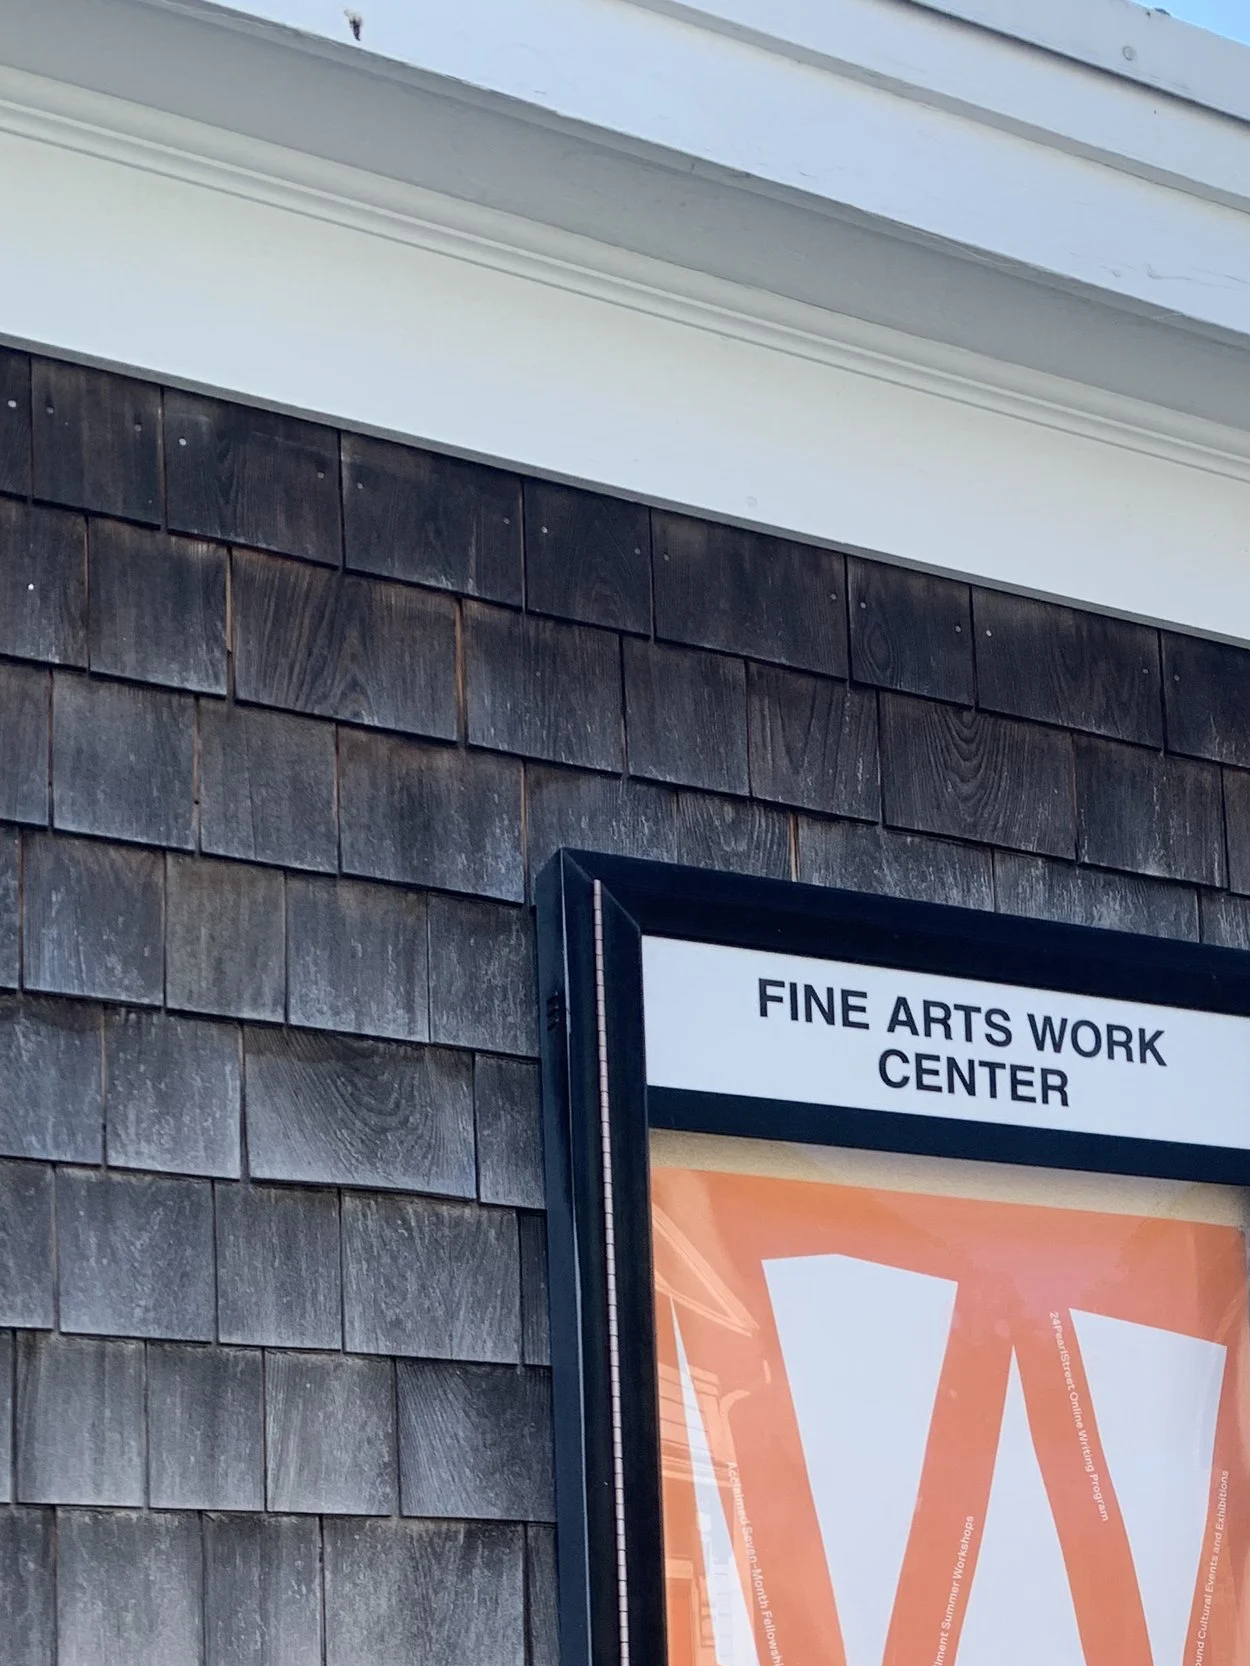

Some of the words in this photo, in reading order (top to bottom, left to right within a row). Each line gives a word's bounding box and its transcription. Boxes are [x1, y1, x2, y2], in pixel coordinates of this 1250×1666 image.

[757, 977, 870, 1030] FINE
[886, 996, 1013, 1047] ARTS
[1027, 1013, 1168, 1067] WORK
[878, 1048, 1070, 1107] CENTER
[1049, 1311, 1075, 1391] 24PearlStreet
[1069, 1391, 1084, 1428] Online
[1078, 1429, 1095, 1473] Writing
[1091, 1474, 1109, 1522] Program
[1215, 1470, 1229, 1531] Exhibitions
[726, 1461, 748, 1525] Acclaimed
[740, 1522, 768, 1608] Seven-Month
[1212, 1532, 1222, 1554] and
[941, 1582, 960, 1629] Summer
[953, 1515, 974, 1580] Workshops
[1204, 1554, 1219, 1593] Events
[1198, 1596, 1212, 1640] Cultural
